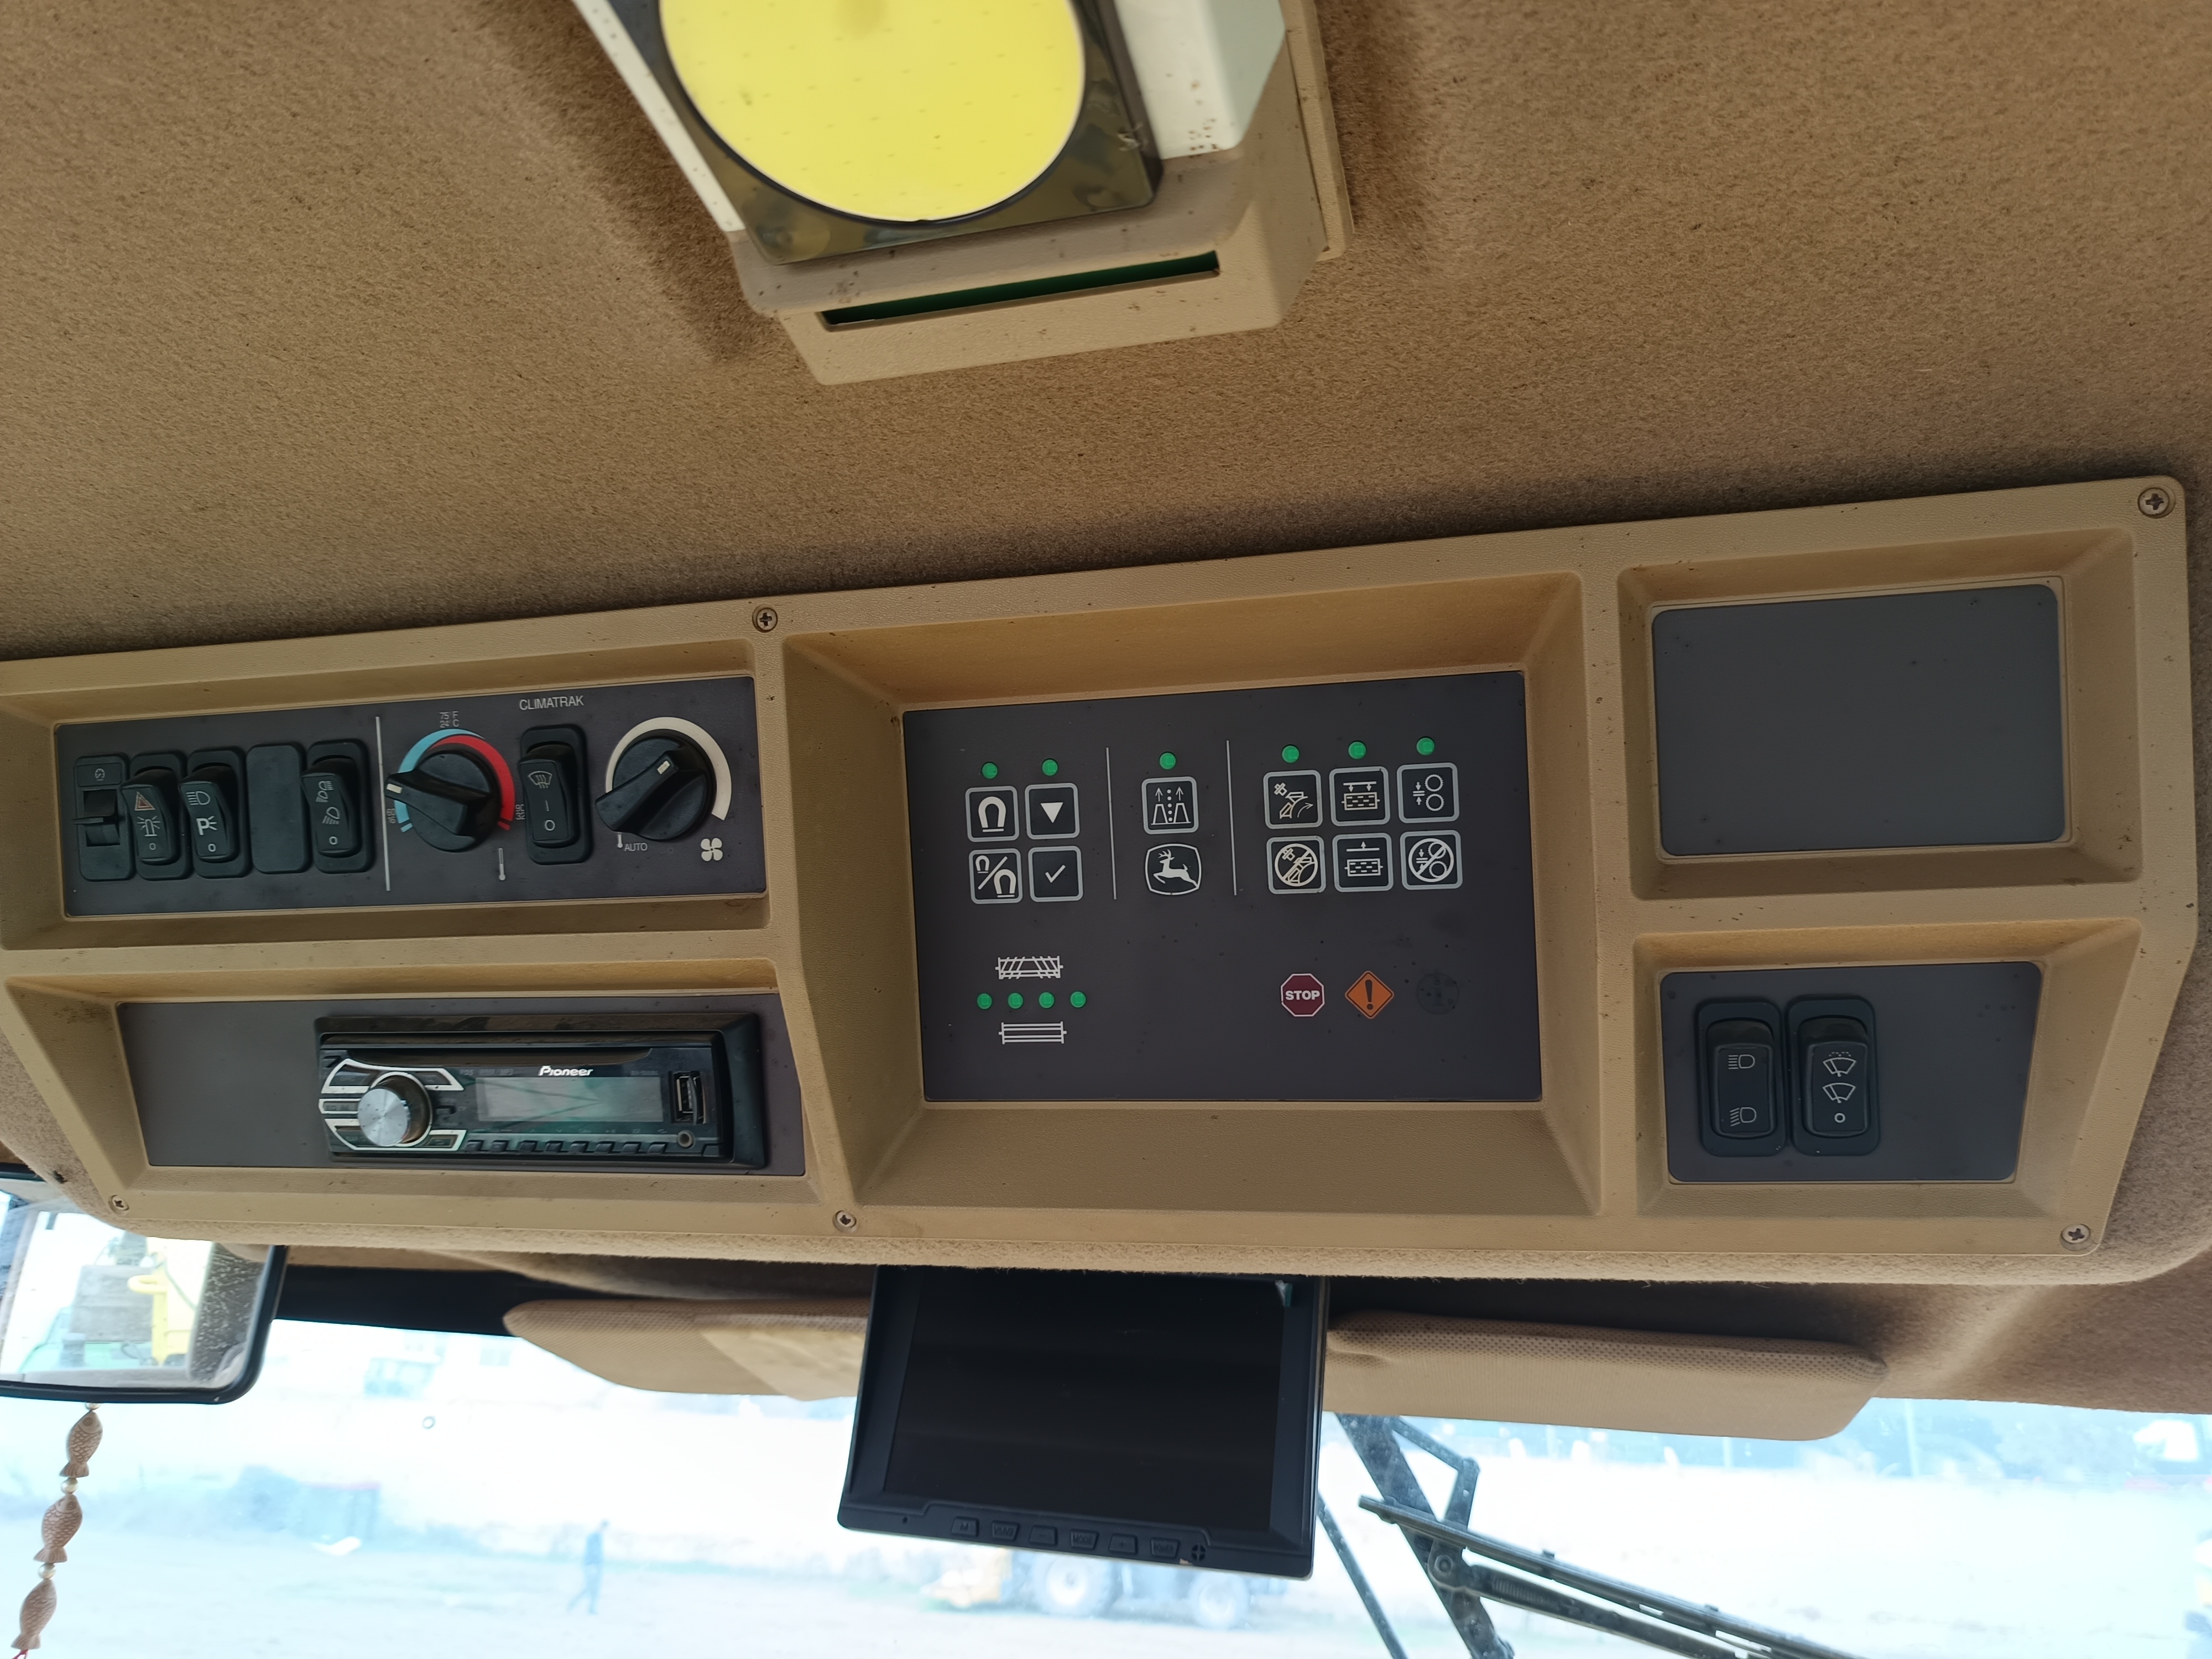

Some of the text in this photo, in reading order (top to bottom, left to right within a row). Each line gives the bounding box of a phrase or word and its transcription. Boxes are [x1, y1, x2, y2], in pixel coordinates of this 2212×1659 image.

[519, 695, 585, 711] CLIMATRAK
[624, 842, 648, 852] AUTO
[1285, 990, 1321, 1000] STOP
[537, 1065, 594, 1076] Pioneer
[1073, 1533, 1093, 1544] MODE
